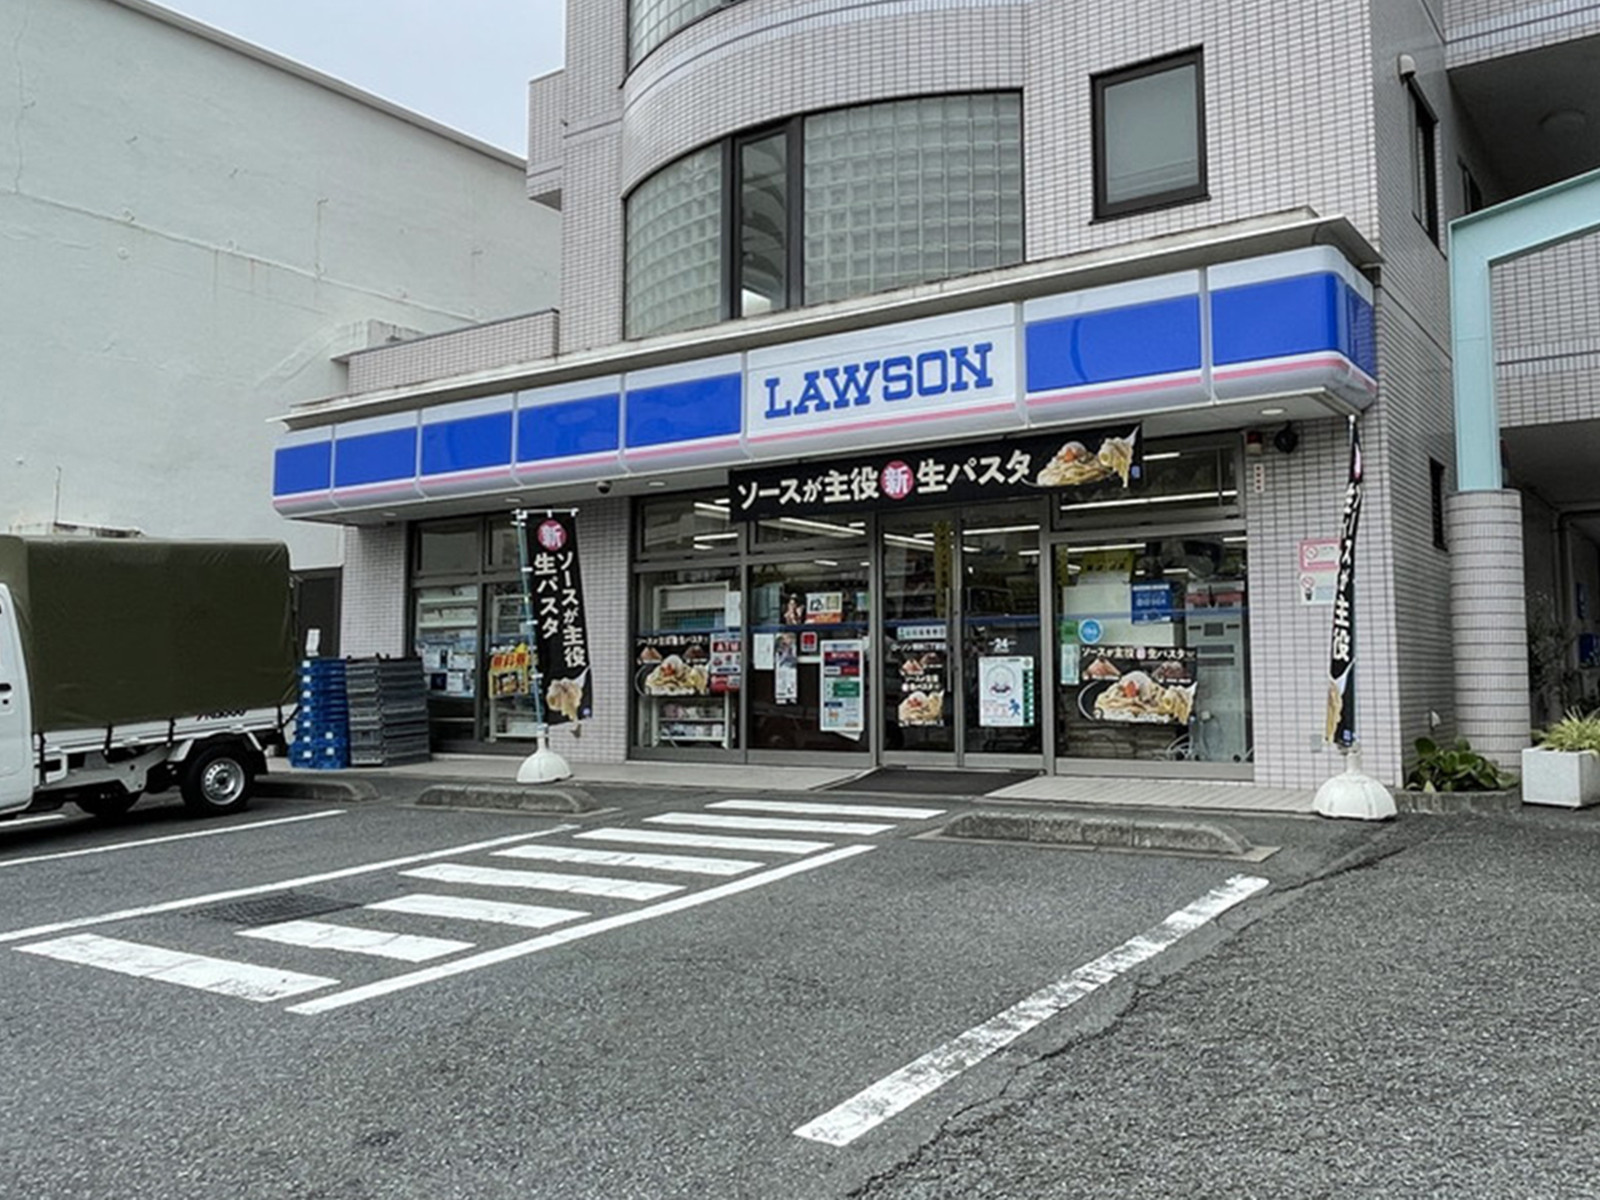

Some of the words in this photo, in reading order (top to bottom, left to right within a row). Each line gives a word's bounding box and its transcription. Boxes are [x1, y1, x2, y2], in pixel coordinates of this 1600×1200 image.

[764, 342, 993, 419] LAWSON
[736, 466, 880, 511] ソースが主役
[881, 460, 912, 498] 新
[916, 449, 1032, 495] 生パスタ
[533, 552, 560, 639] 生パスタ
[557, 551, 587, 668] ソースが主役
